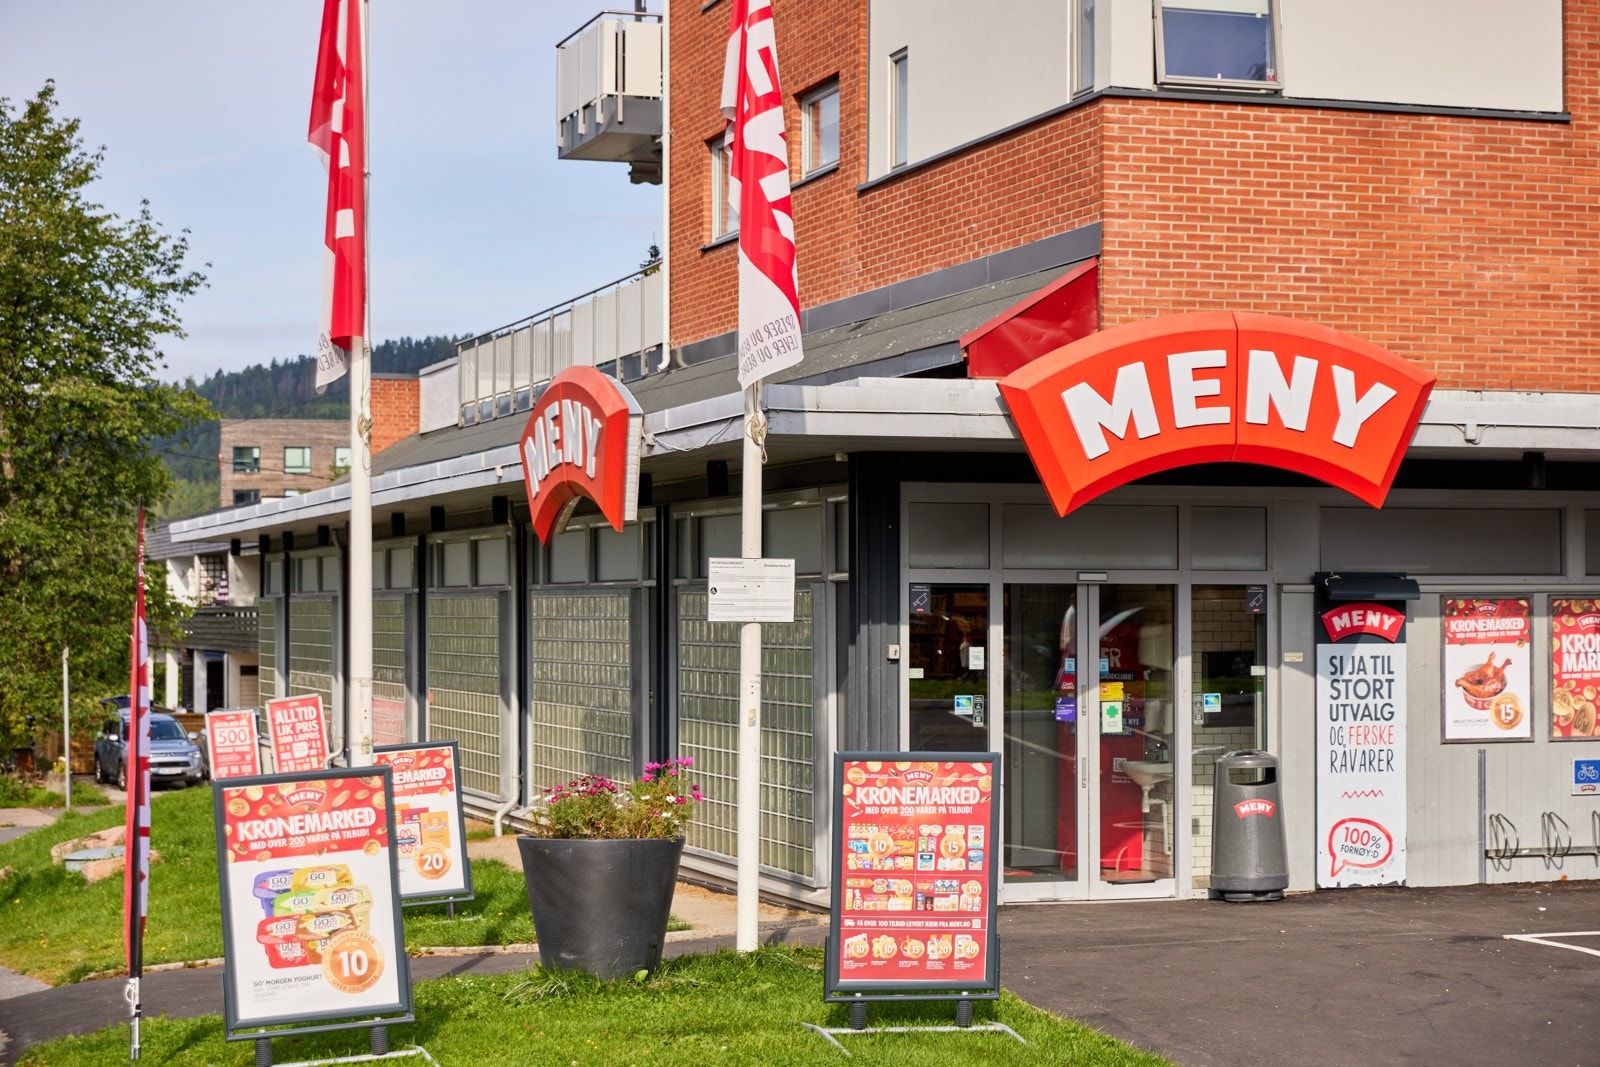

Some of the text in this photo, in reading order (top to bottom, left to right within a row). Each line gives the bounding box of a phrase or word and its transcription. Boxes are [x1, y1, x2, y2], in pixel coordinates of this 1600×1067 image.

[1061, 349, 1398, 460] MENY
[524, 399, 602, 499] MENY
[1331, 609, 1396, 632] MENY
[1450, 618, 1525, 632] KRONEMARKED
[1582, 616, 1600, 625] MEN
[1329, 655, 1395, 676] SI JA TIL
[1562, 653, 1600, 672] MAR
[1329, 678, 1395, 700] STORT
[275, 706, 317, 724] ALLTID
[1329, 702, 1395, 722] UTVALG
[1500, 704, 1515, 720] 15
[218, 729, 248, 744] 500
[277, 720, 320, 737] LIK PRIS
[1330, 725, 1395, 746] OG FERSKE
[1330, 743, 1395, 773] RÅVARER
[906, 771, 931, 781] MENY
[290, 790, 323, 804] MENY
[856, 786, 980, 805] KRONEMARKED
[865, 805, 973, 815] MED OVER 200 VARER PÅ TILBUD!
[1239, 803, 1273, 815] MENY
[238, 807, 376, 841] KRONEMARKED
[251, 828, 370, 850] MED OVER 200 VARER PÅ TILBUD!
[875, 840, 887, 852] 10
[1344, 826, 1382, 849] 100%
[947, 841, 959, 853] 15
[422, 853, 444, 871] 20
[338, 949, 369, 977] 10
[266, 977, 292, 986] MORGEN
[293, 974, 323, 982] YOGHURT
